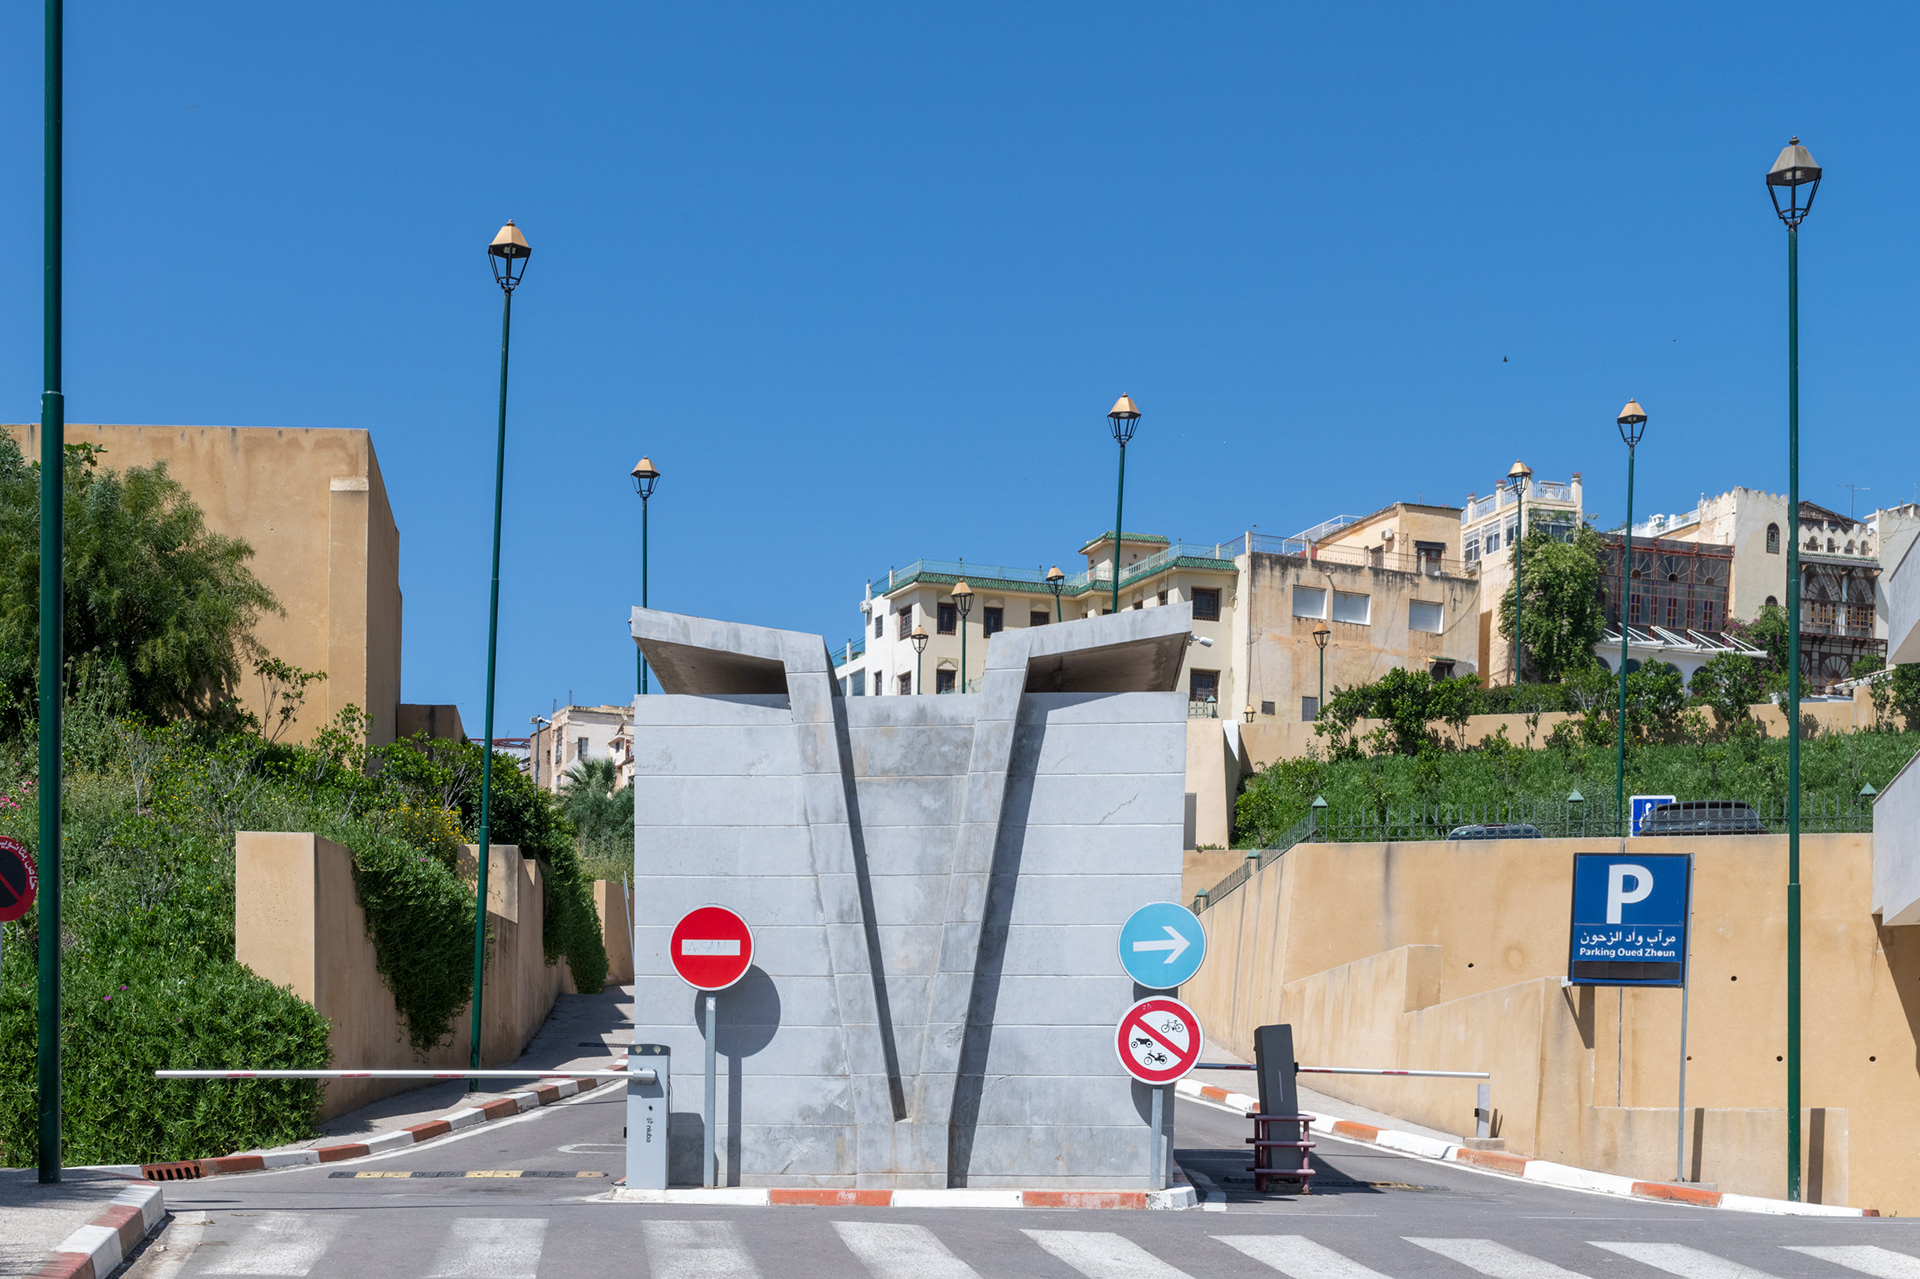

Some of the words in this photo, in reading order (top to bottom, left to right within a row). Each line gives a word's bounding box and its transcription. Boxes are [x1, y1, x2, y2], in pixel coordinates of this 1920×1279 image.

[0, 840, 28, 861] بثانوي
[1606, 864, 1653, 924] P
[1580, 930, 1622, 945] الزحون
[1625, 930, 1643, 946] واد
[1646, 929, 1676, 946] مرآب
[1579, 947, 1616, 958] Parking
[1617, 947, 1643, 957] Oued
